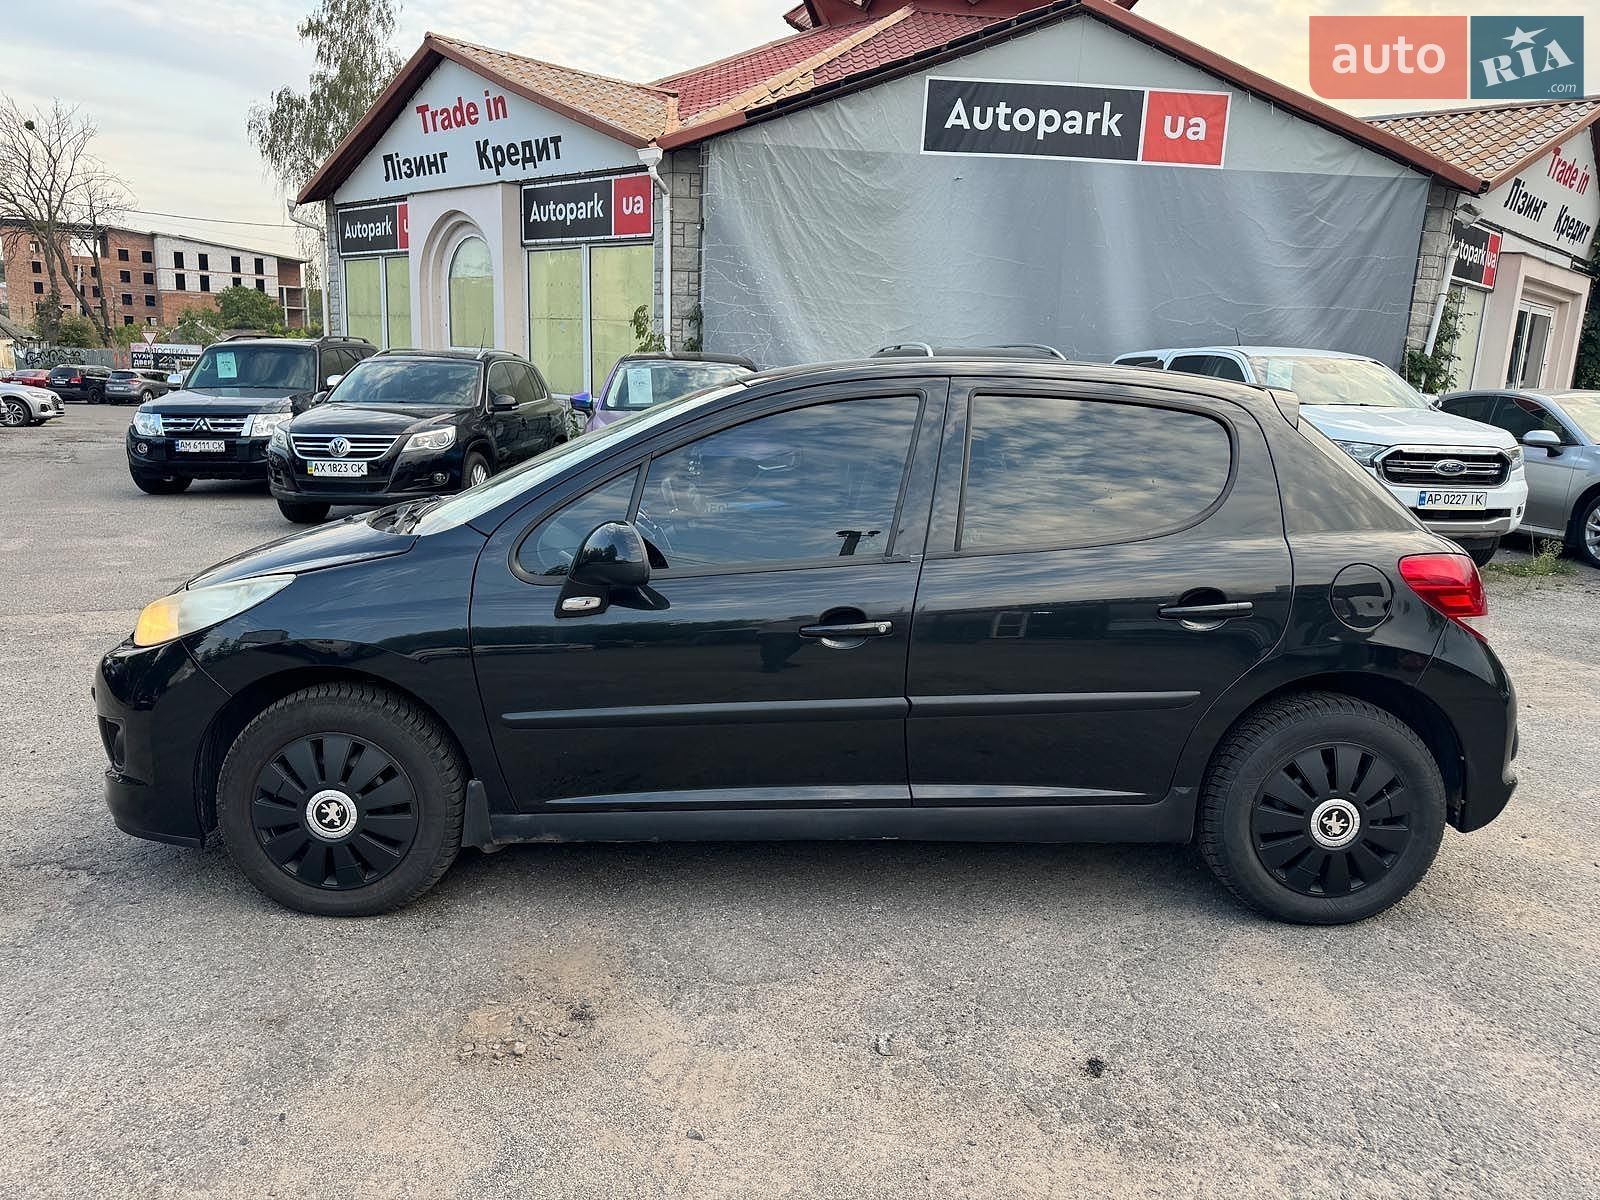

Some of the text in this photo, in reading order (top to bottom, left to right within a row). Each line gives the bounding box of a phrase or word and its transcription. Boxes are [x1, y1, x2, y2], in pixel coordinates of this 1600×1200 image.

[416, 90, 507, 134] Trade in
[944, 97, 1206, 141] Autopark ua
[382, 135, 562, 182] Лізинг Кредит
[1546, 146, 1590, 195] Trade in
[530, 192, 644, 225] Autopark ua
[1504, 177, 1591, 245] Лізинг Кредит
[345, 215, 392, 241] Autopark
[1452, 233, 1486, 267] topark
[193, 441, 210, 450] 6111
[314, 463, 365, 473] AX 1823 CK
[1427, 494, 1484, 506] AP 0227 IK
